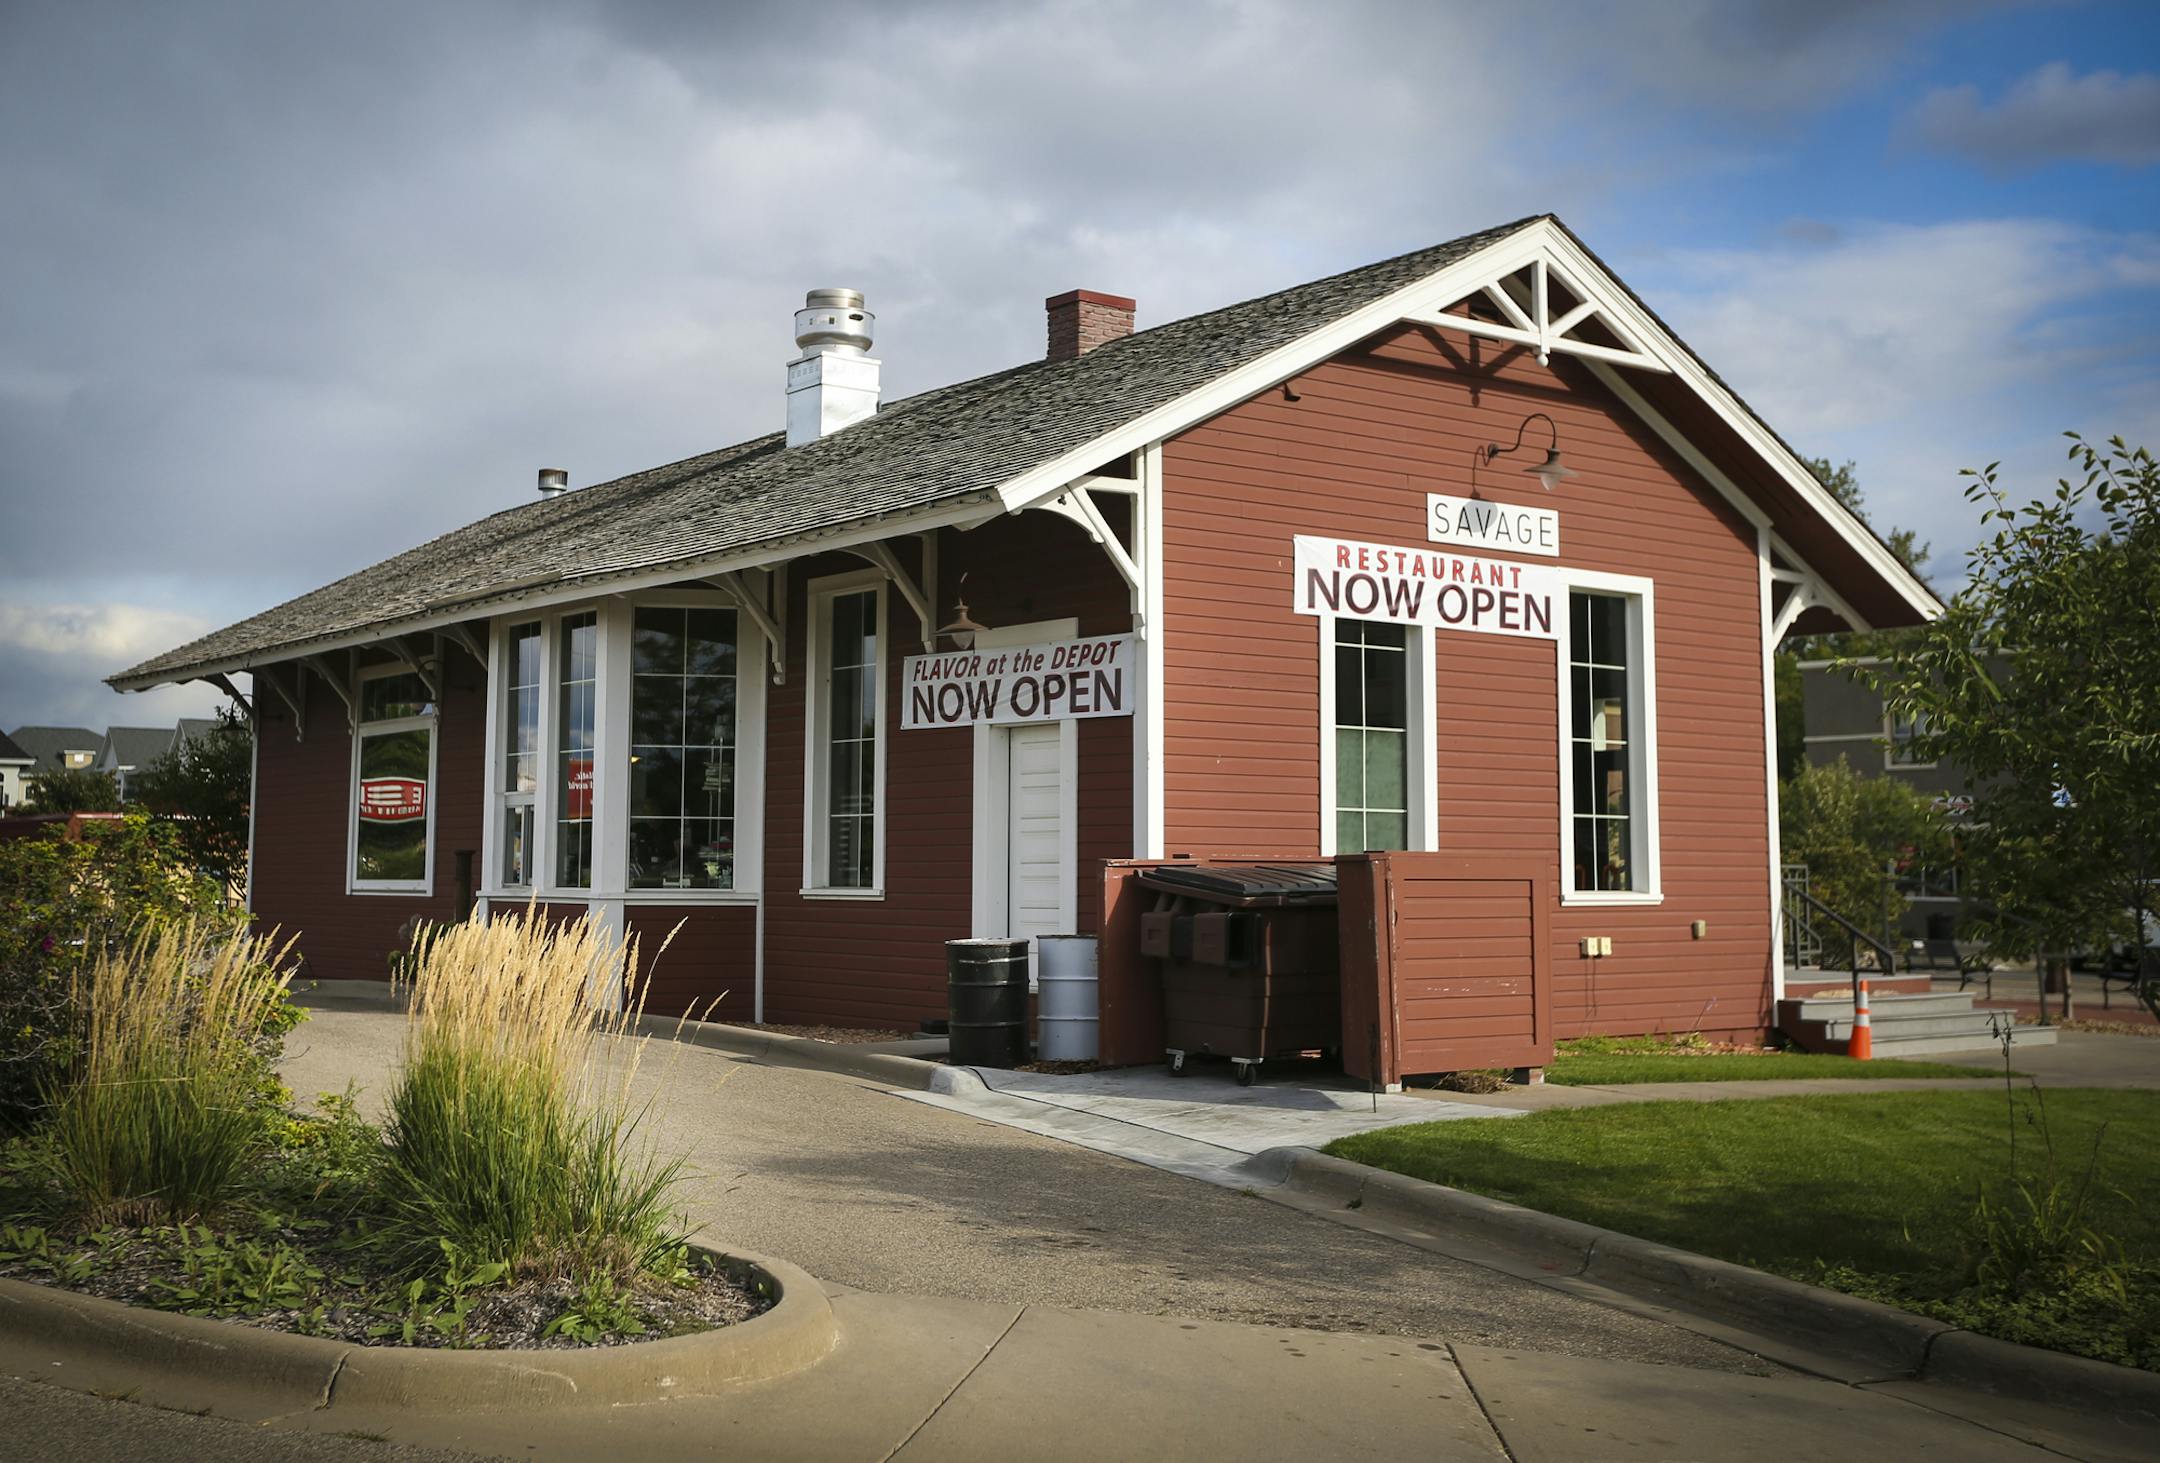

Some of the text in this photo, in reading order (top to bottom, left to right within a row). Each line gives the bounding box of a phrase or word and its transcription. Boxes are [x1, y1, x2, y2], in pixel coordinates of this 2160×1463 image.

[1434, 503, 1553, 547] SAVAGE
[1336, 545, 1521, 588] RESTAURANT
[1307, 568, 1551, 633] NOW OPEN
[913, 640, 1122, 681] FLAVOR at the DEPOT
[912, 668, 1122, 724] NOW OPEN
